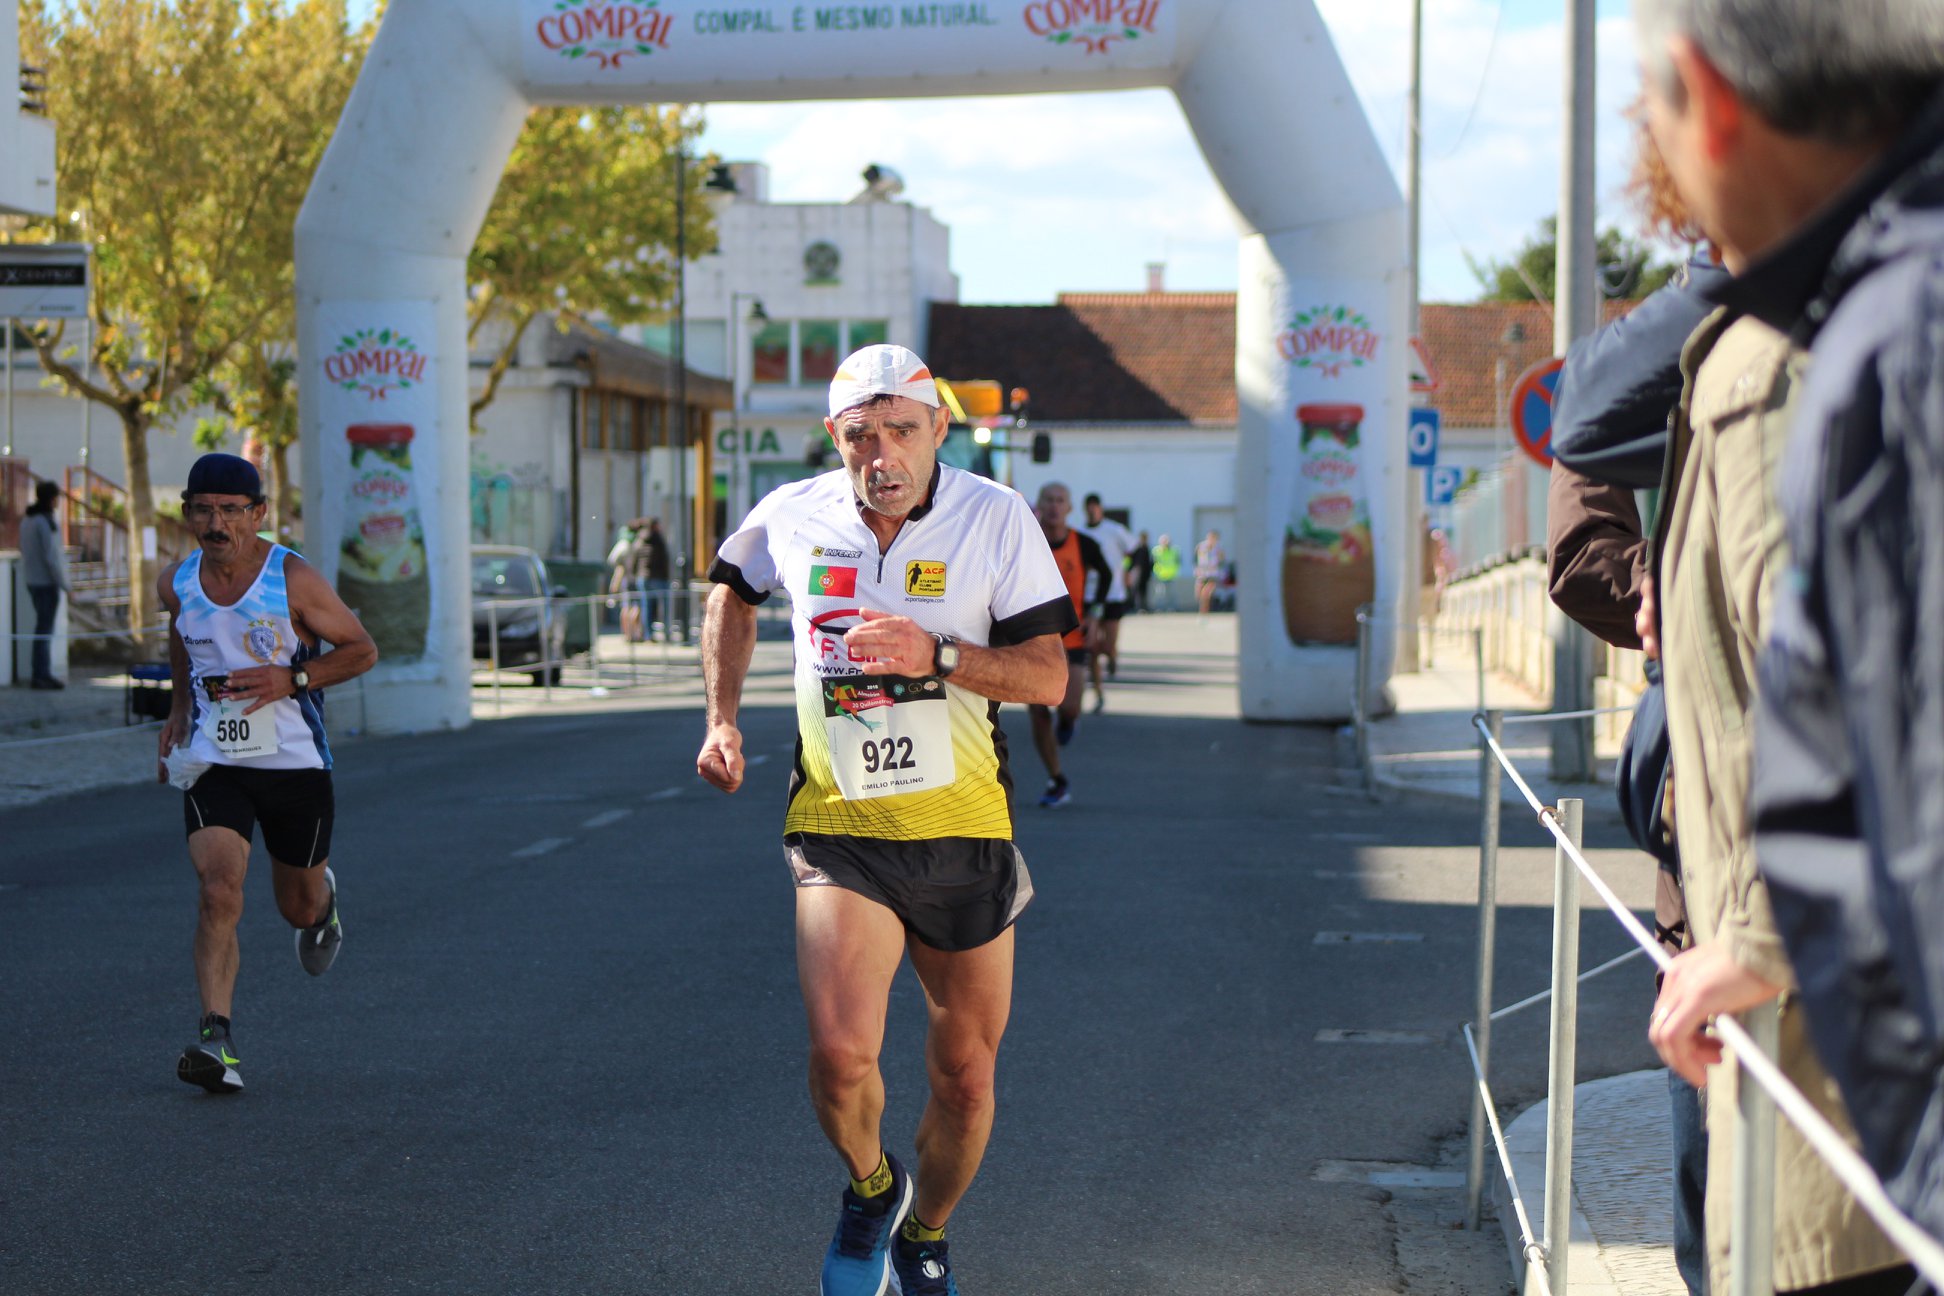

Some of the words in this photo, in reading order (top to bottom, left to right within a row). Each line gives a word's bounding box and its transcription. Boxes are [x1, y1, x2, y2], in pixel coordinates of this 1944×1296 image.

[815, 5, 893, 31] MESMO
[1431, 468, 1456, 501] P
[217, 718, 250, 742] 580
[862, 736, 916, 774] 922
[890, 776, 924, 787] PAULINO
